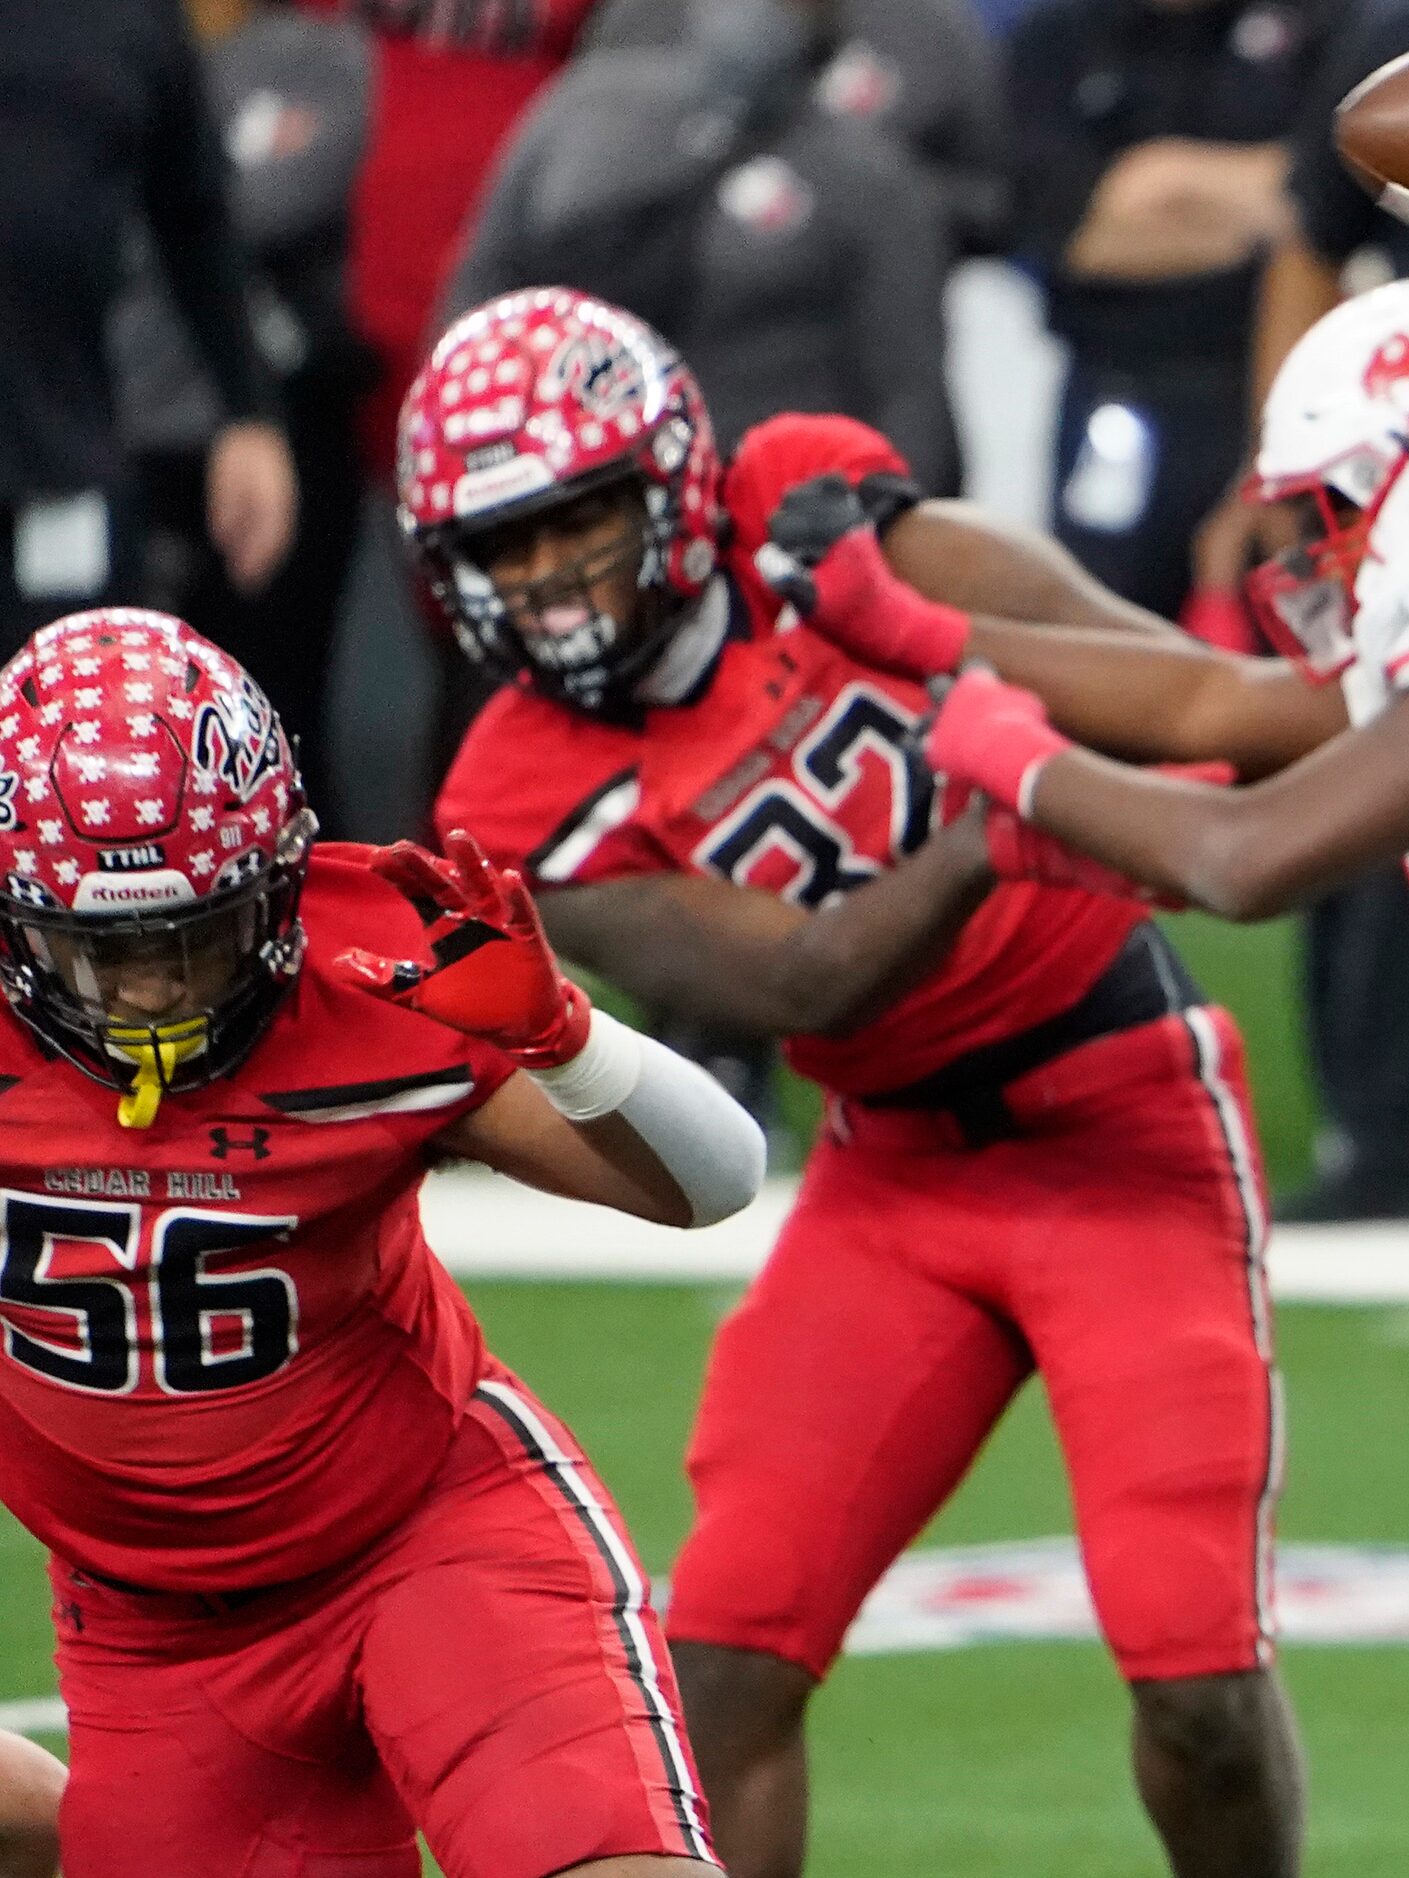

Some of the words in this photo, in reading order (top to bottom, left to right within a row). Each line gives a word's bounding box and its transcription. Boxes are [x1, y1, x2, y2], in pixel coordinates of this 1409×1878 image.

[91, 885, 179, 901] Riddell
[44, 1167, 150, 1197] CEDAR
[166, 1171, 241, 1200] HILL
[0, 1187, 299, 1395] 56
